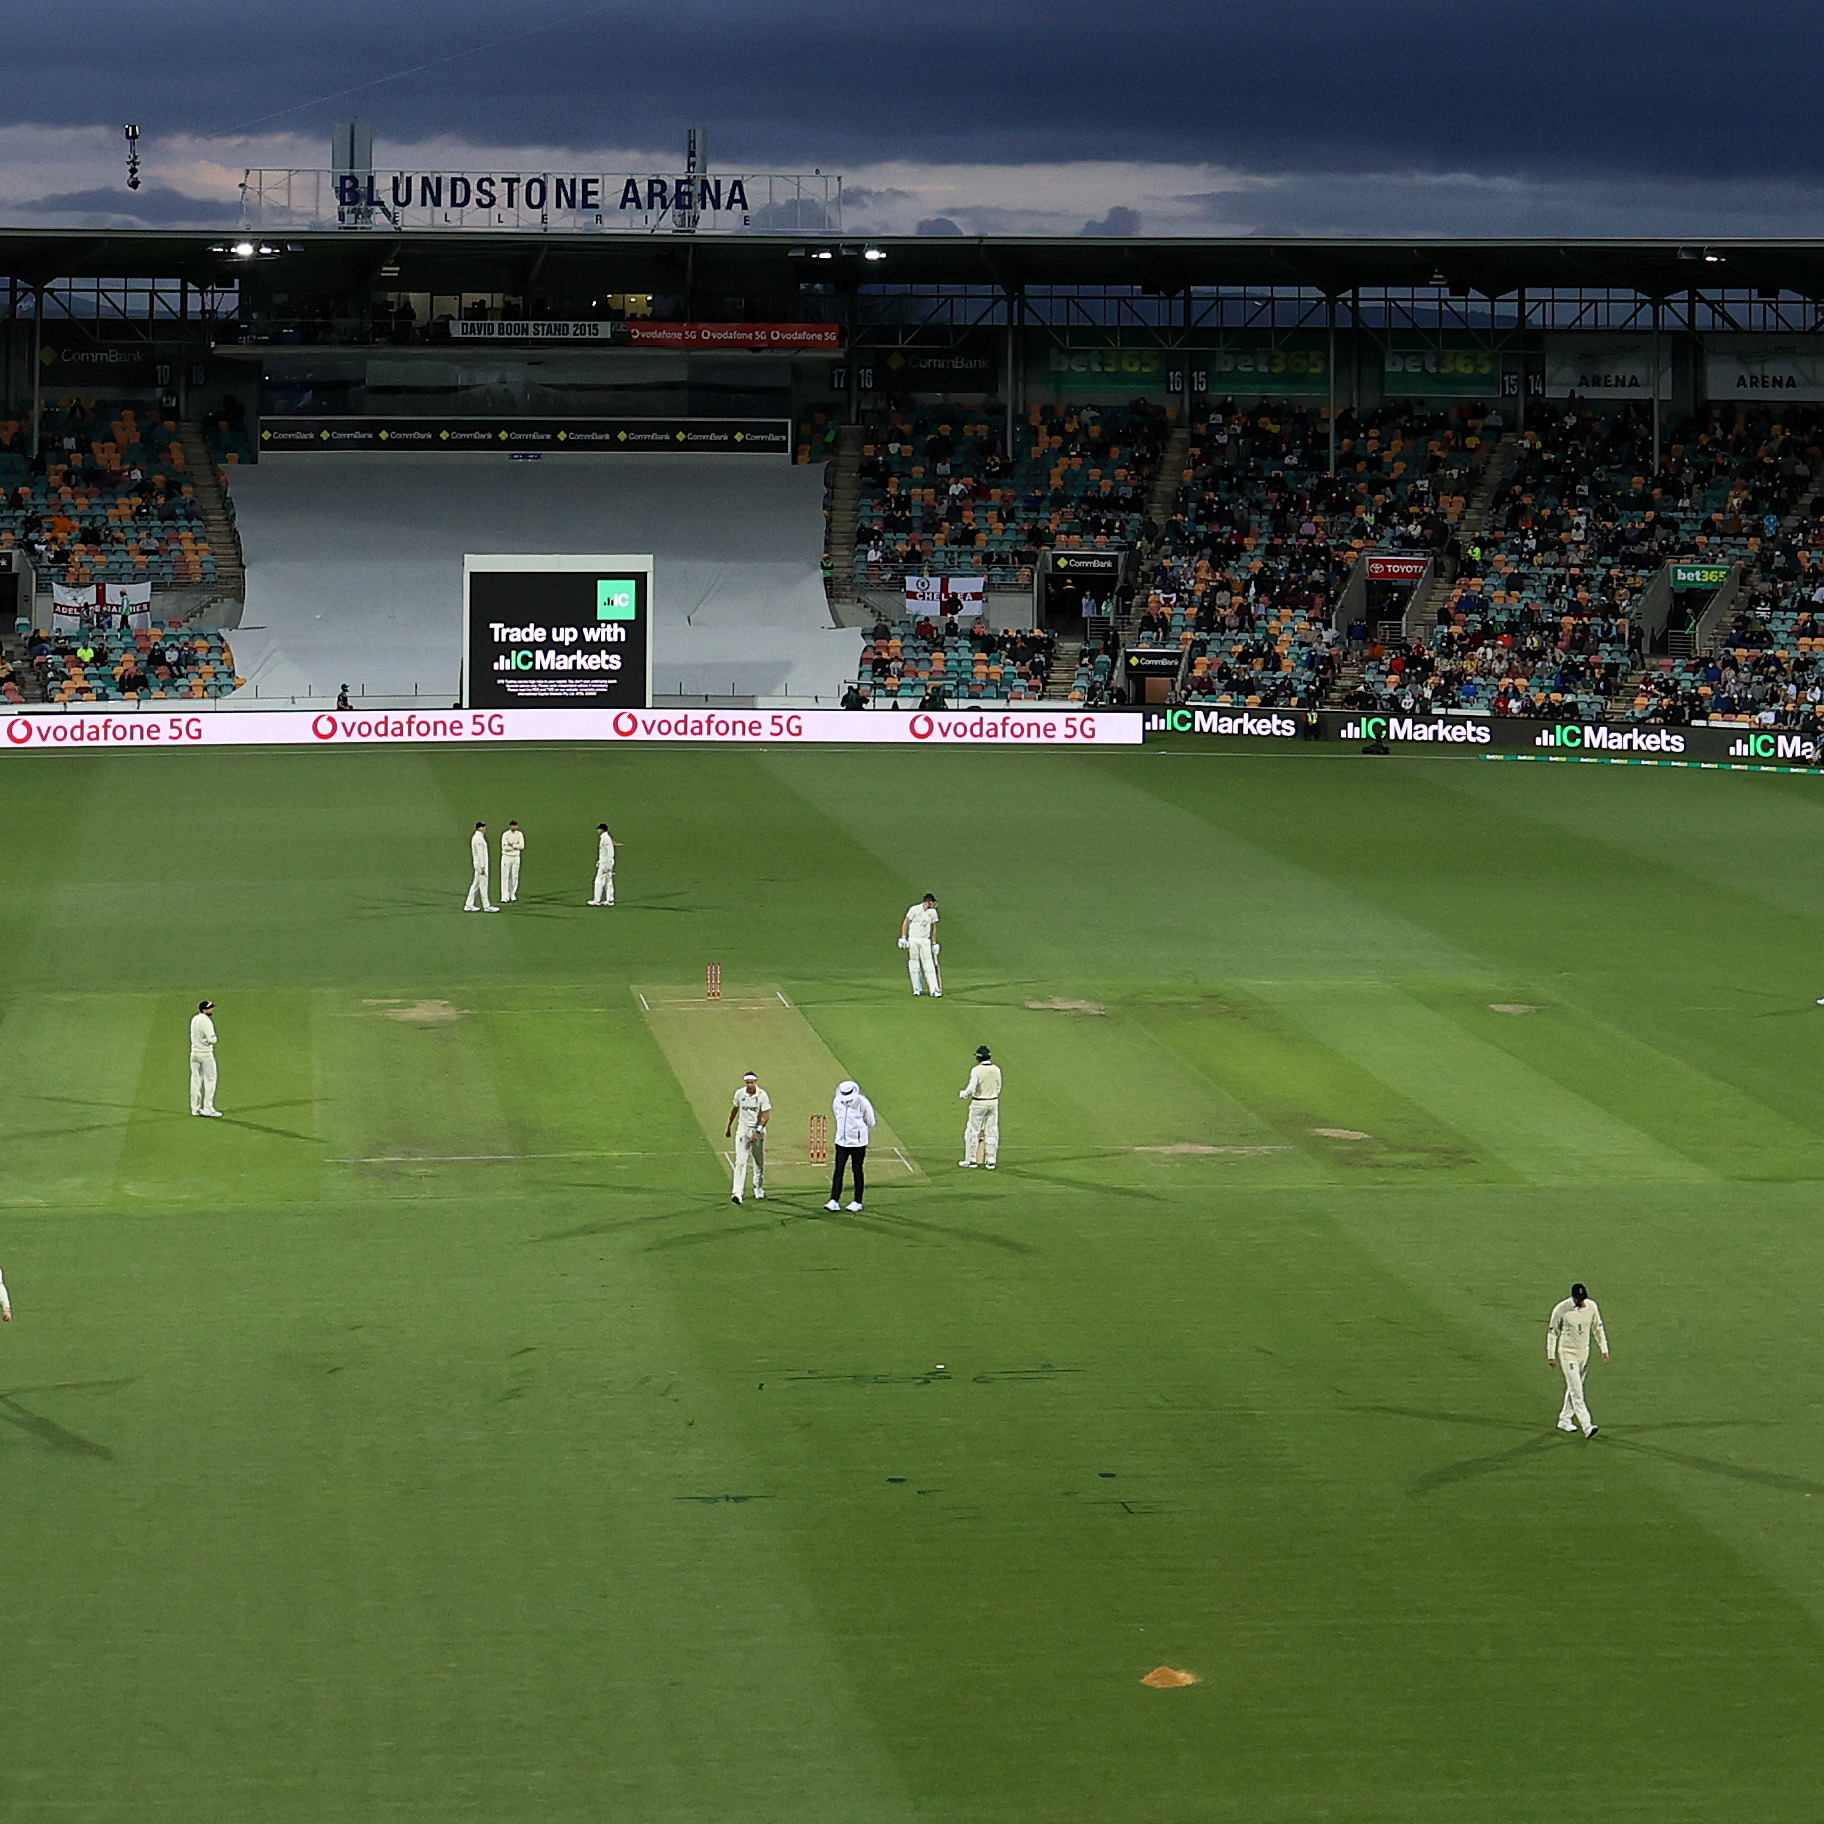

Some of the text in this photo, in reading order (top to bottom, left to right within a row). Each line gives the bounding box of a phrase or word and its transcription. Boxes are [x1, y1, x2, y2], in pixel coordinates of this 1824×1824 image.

[338, 176, 749, 211] BLUNDSTONE ARENA
[461, 322, 600, 337] DAVID BOON STAND 2015
[640, 328, 697, 340] vodafone 5G
[711, 329, 767, 341] vodafone 5G
[780, 330, 837, 341] vodafone 5G
[61, 348, 143, 363] CommBank
[908, 354, 991, 369] CommBank
[1049, 347, 1160, 373] bet365
[1216, 348, 1326, 374] bet365
[1386, 350, 1493, 375] bet365
[832, 369, 846, 388] 17
[859, 368, 873, 388] 16
[1168, 371, 1182, 392] 16
[1192, 371, 1207, 392] 15
[1503, 375, 1519, 395] 15
[1529, 375, 1543, 395] 14
[1578, 374, 1641, 389] ARENA
[1736, 375, 1797, 389] ARENA
[1067, 558, 1113, 569] CommBank
[1677, 568, 1726, 582] bet365
[916, 592, 973, 601] CHELEA
[489, 622, 626, 646] Trade up with
[535, 649, 622, 670] Markets
[37, 718, 202, 742] vodafone 5G
[342, 714, 504, 737] vodafone 5G
[642, 713, 802, 737] vodafone 5G
[938, 716, 1095, 739] vodafone 5G
[1194, 711, 1296, 737] Markets
[1389, 718, 1491, 744] Markets
[1584, 725, 1685, 753] Markets
